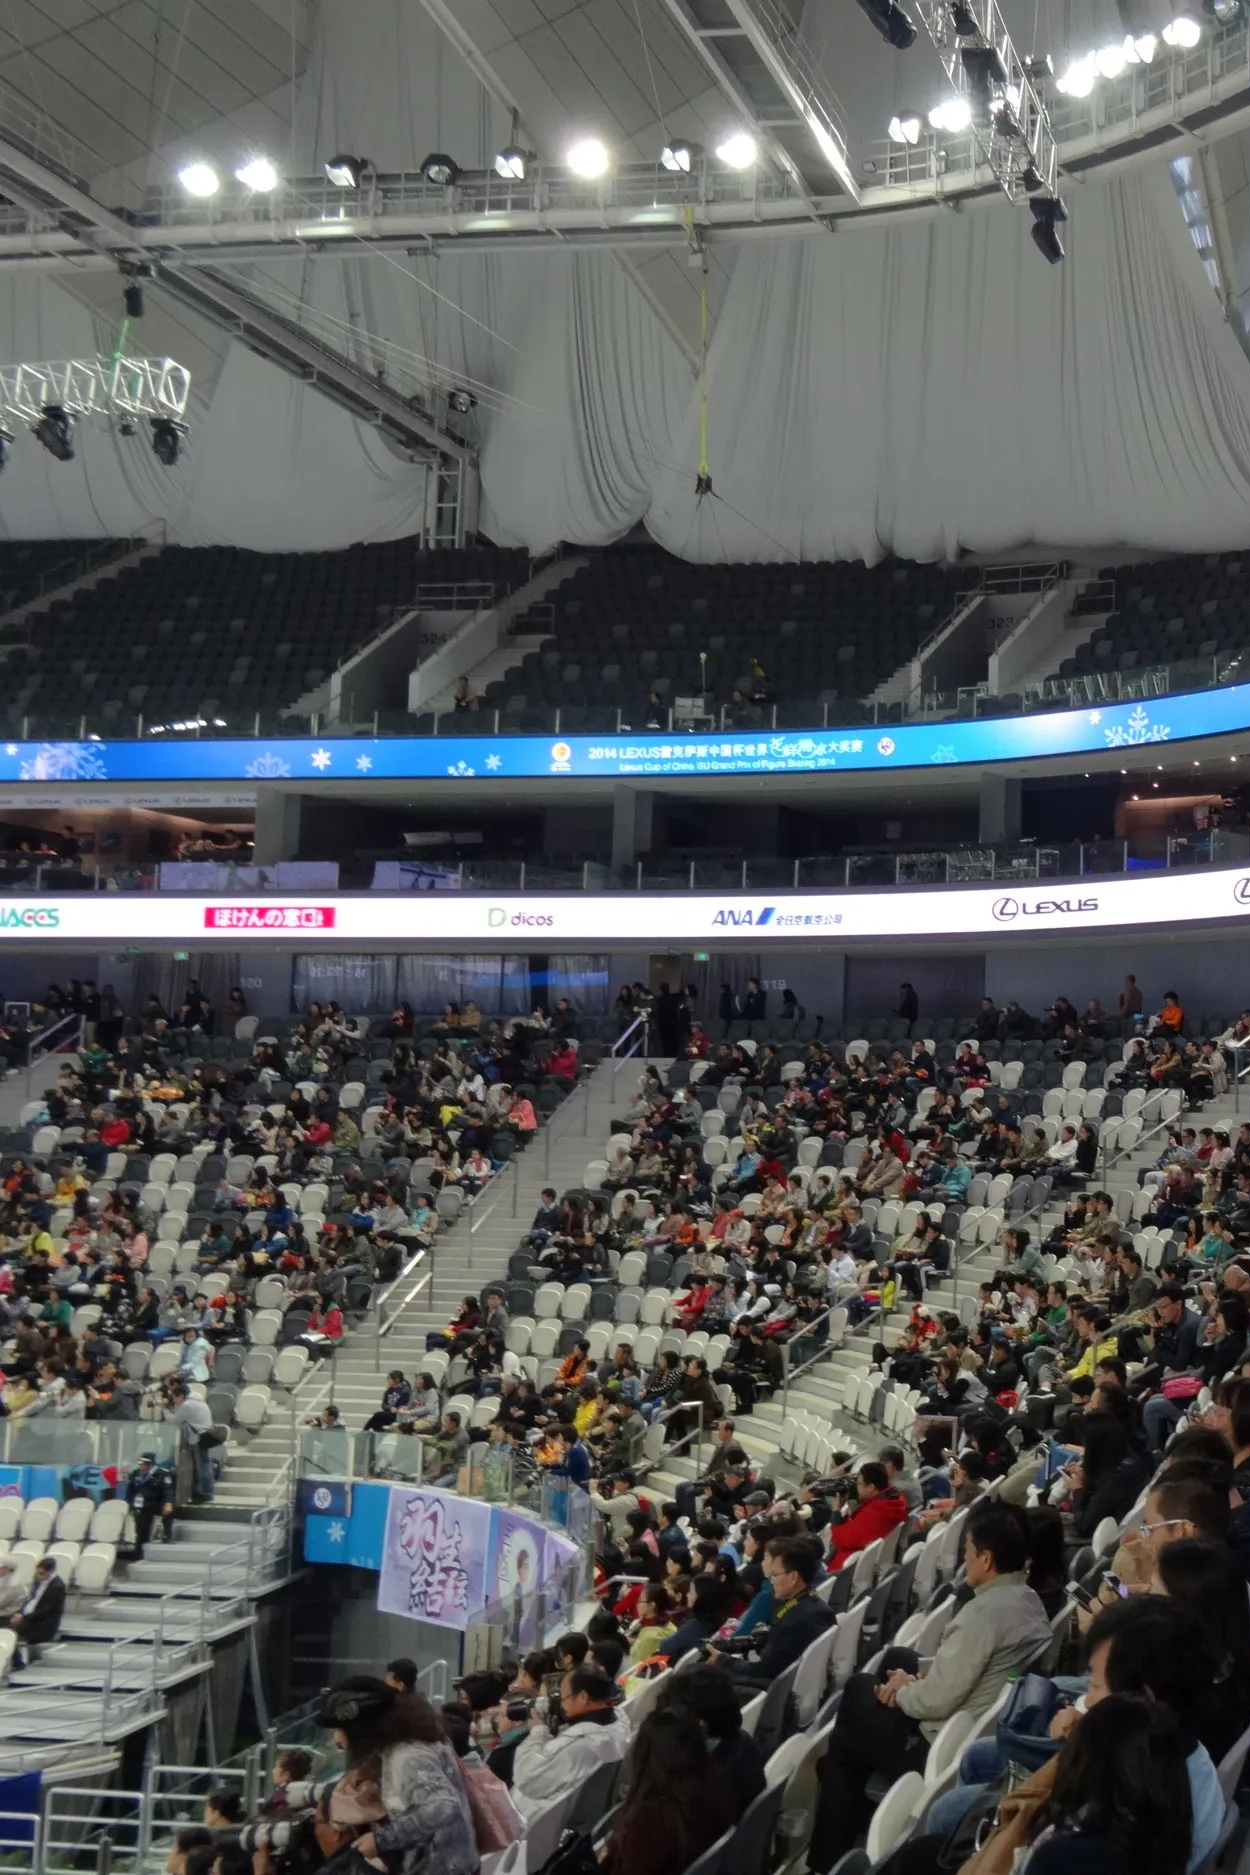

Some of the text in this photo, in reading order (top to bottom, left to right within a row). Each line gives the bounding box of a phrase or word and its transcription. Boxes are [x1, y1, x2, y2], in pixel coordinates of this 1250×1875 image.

[588, 747, 617, 759] 2014
[1022, 898, 1099, 915] LEXUS
[511, 912, 554, 926] dicos
[711, 909, 753, 926] ANA
